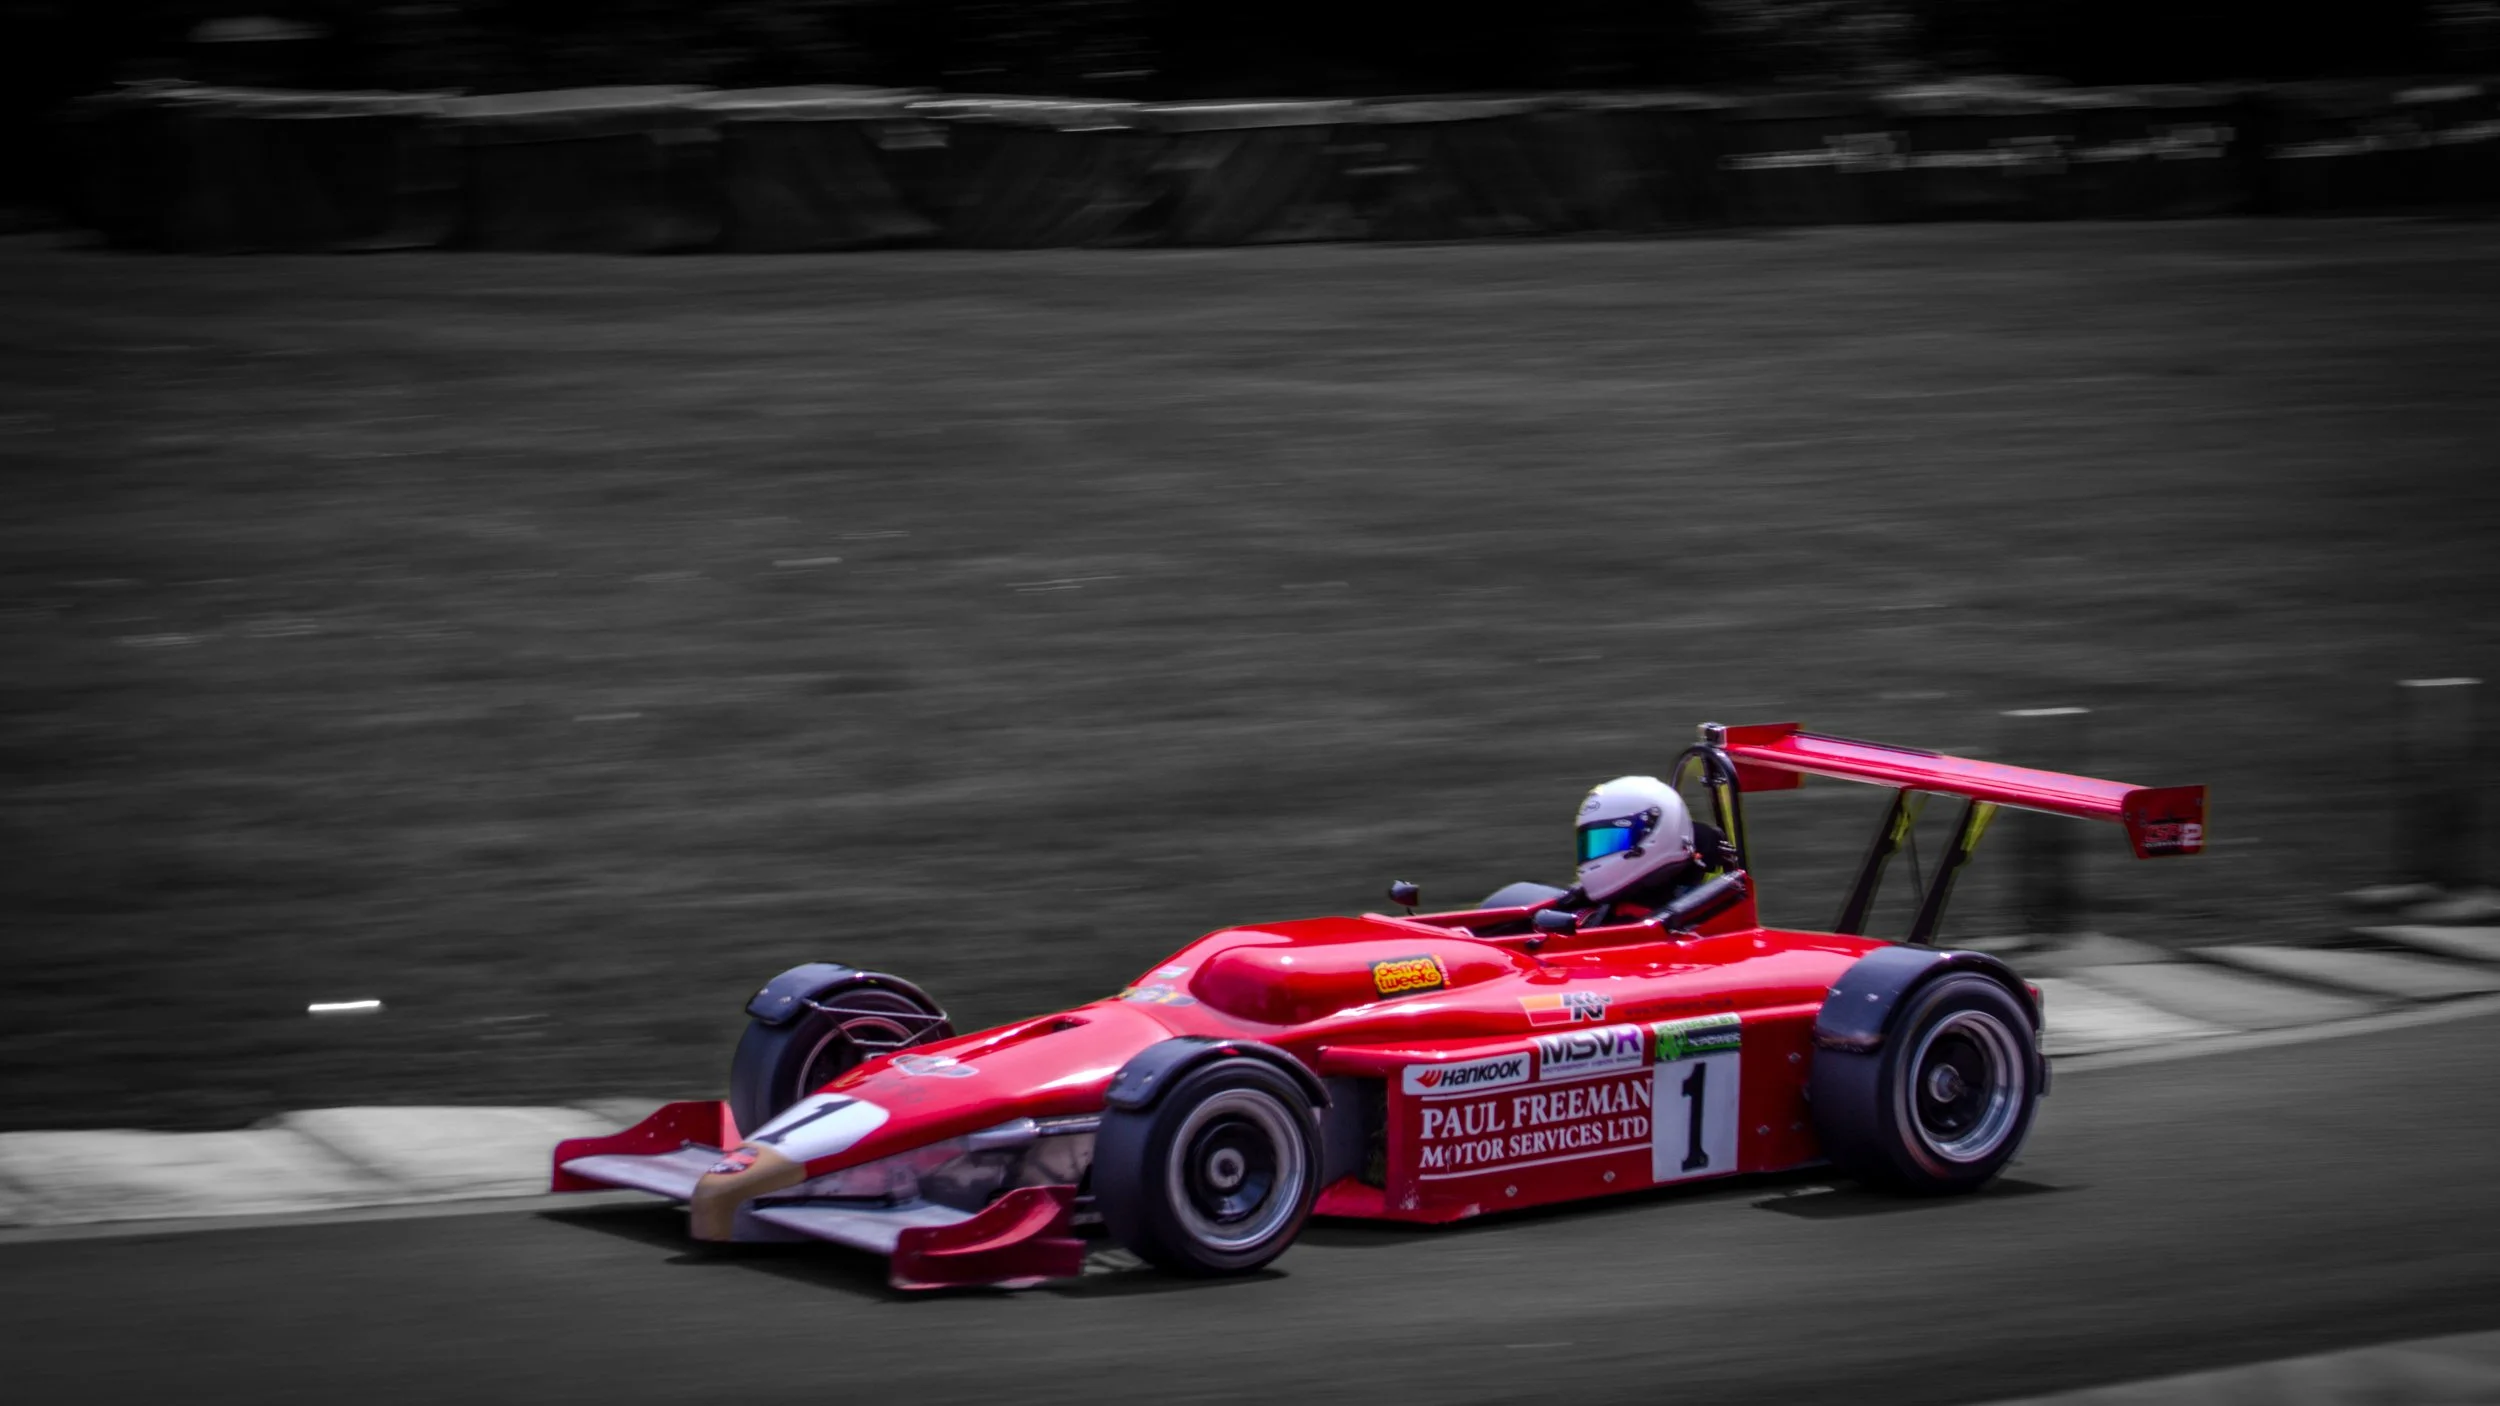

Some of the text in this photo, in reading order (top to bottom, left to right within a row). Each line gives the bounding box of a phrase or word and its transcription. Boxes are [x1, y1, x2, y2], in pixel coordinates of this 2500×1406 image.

[1542, 1028, 1641, 1065] MSVR
[753, 1099, 861, 1145] 1
[1419, 1078, 1653, 1140] PAUL FREEMAN
[1681, 1062, 1709, 1172] 1
[1419, 1115, 1649, 1170] MOTOR SERVICES LTD
